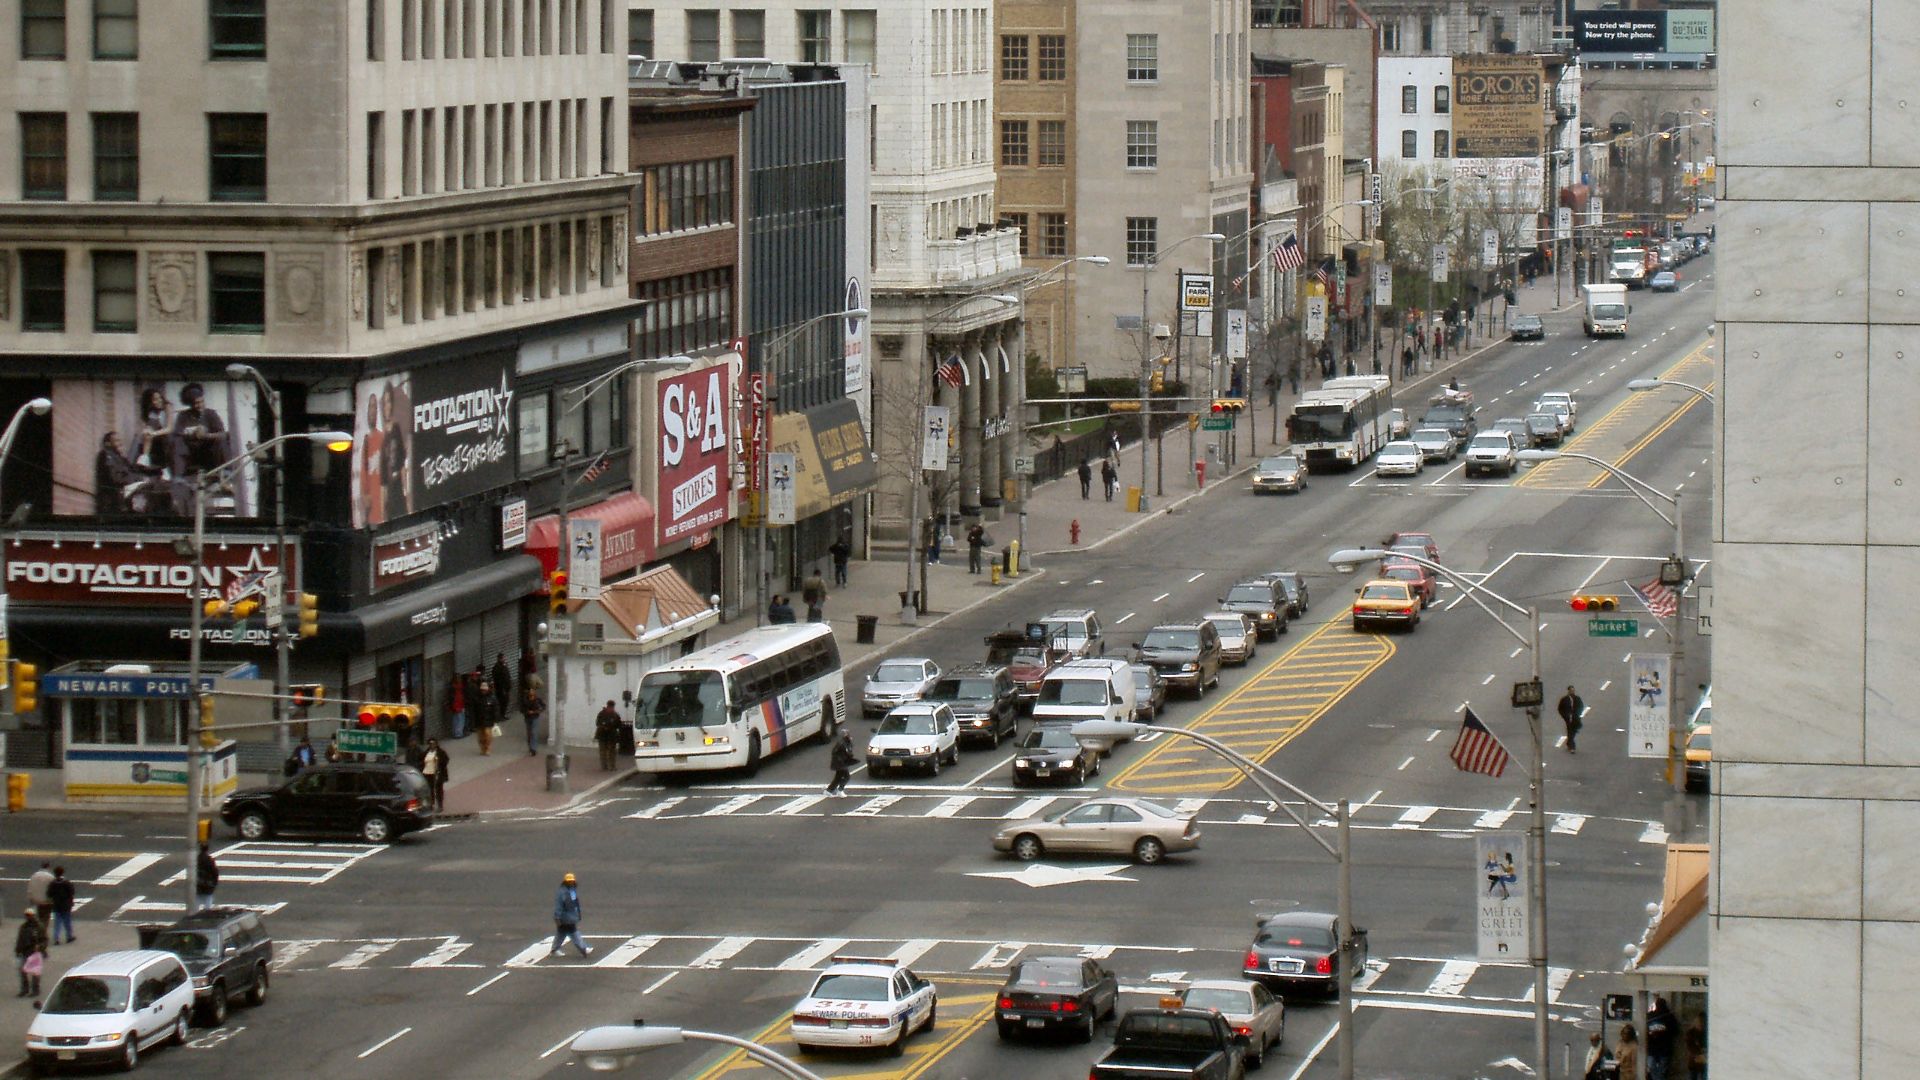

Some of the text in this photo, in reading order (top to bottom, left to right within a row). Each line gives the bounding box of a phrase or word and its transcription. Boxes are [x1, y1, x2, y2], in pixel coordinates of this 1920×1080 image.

[1632, 22, 1656, 30] power.
[1461, 75, 1536, 94] BOROK'S
[414, 388, 494, 433] FOOTACTION
[675, 471, 714, 514] STORES
[604, 529, 636, 560] AVENUE
[7, 561, 222, 587] FOOTACTION
[1590, 621, 1628, 632] Market
[57, 680, 211, 693] NEWARK POLIE
[340, 733, 382, 746] Market
[1481, 918, 1523, 929] GREET
[811, 1010, 870, 1019] NEWARK POLICE
